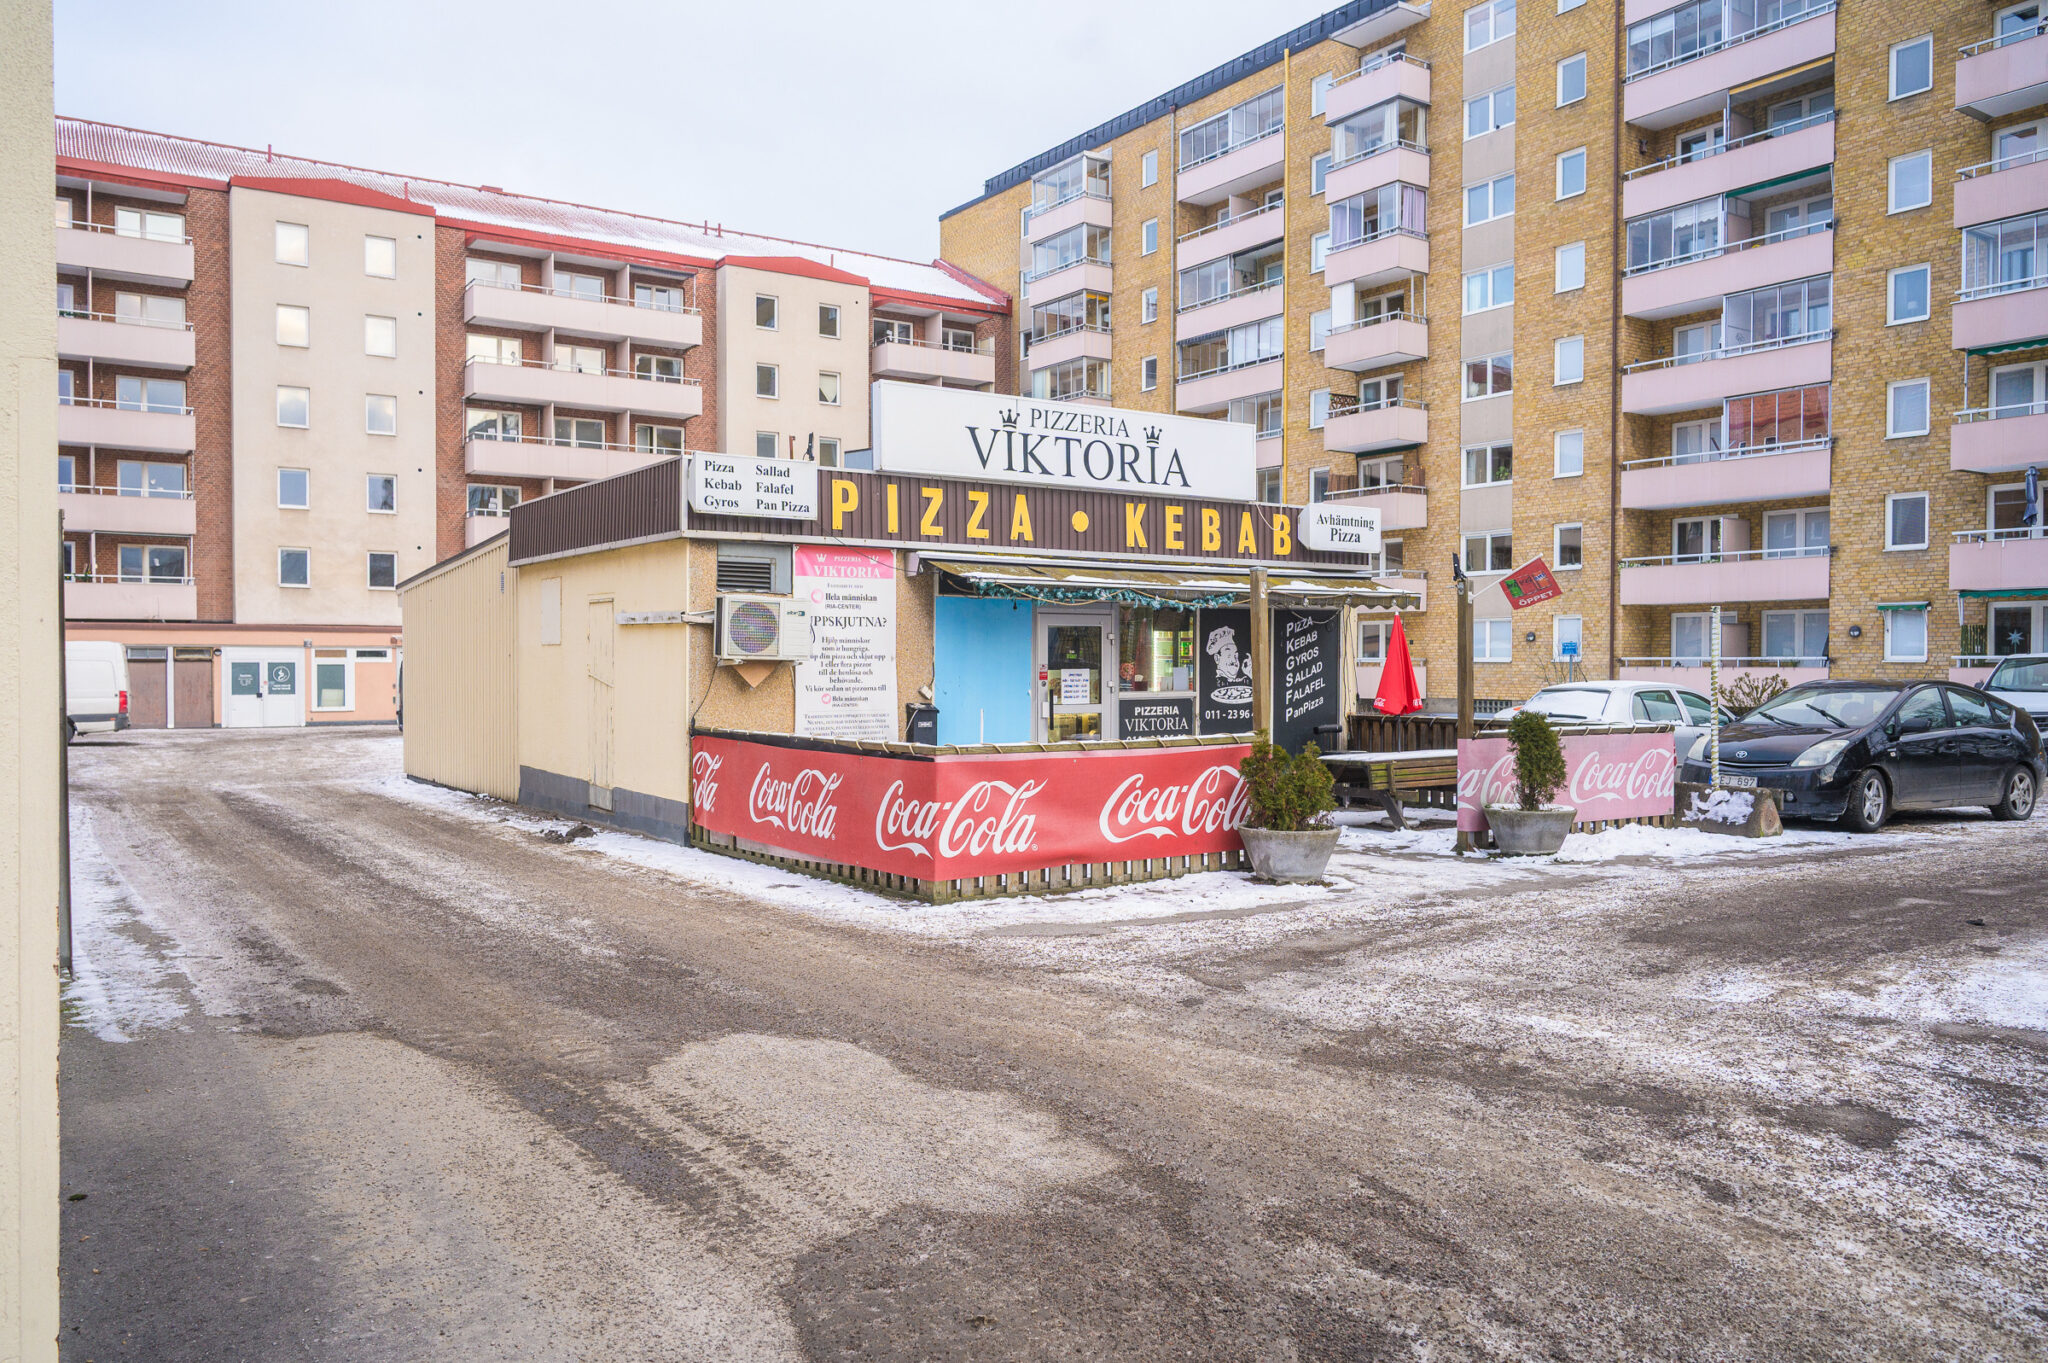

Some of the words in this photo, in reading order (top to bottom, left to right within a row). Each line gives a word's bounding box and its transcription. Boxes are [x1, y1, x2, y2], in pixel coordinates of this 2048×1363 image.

[1030, 408, 1130, 438] PIZZERIA
[965, 425, 1191, 488] VIKTORIA
[704, 460, 734, 473] Pizza
[756, 465, 790, 478] Sallad
[704, 478, 742, 491] Kebab
[756, 482, 794, 495] Falafel
[704, 495, 739, 509] Gyros
[756, 499, 777, 510] Pan
[781, 501, 810, 513] Pizza
[831, 479, 1034, 541] PIZZA
[1125, 503, 1292, 555] KEBAB
[1316, 513, 1374, 531] Avhämtning
[1330, 528, 1361, 543] Pizza
[814, 565, 880, 578] VIKTORIA
[1518, 590, 1553, 606] ÖPPET
[1286, 616, 1314, 637] PIZZA
[1286, 630, 1318, 654] KEBAB
[1286, 646, 1319, 671] GYROS
[1285, 661, 1323, 688] SALLAD
[1285, 677, 1326, 705] FALAFEL
[1134, 705, 1179, 715] PIZZERIA
[1205, 710, 1220, 719] 011
[1227, 710, 1238, 719] 23
[1239, 709, 1250, 718] 96
[1125, 716, 1189, 732] VIKTORIA
[1737, 778, 1755, 787] 697
[750, 762, 844, 840] Coca-Cola
[876, 778, 1048, 860] Coca-Cola
